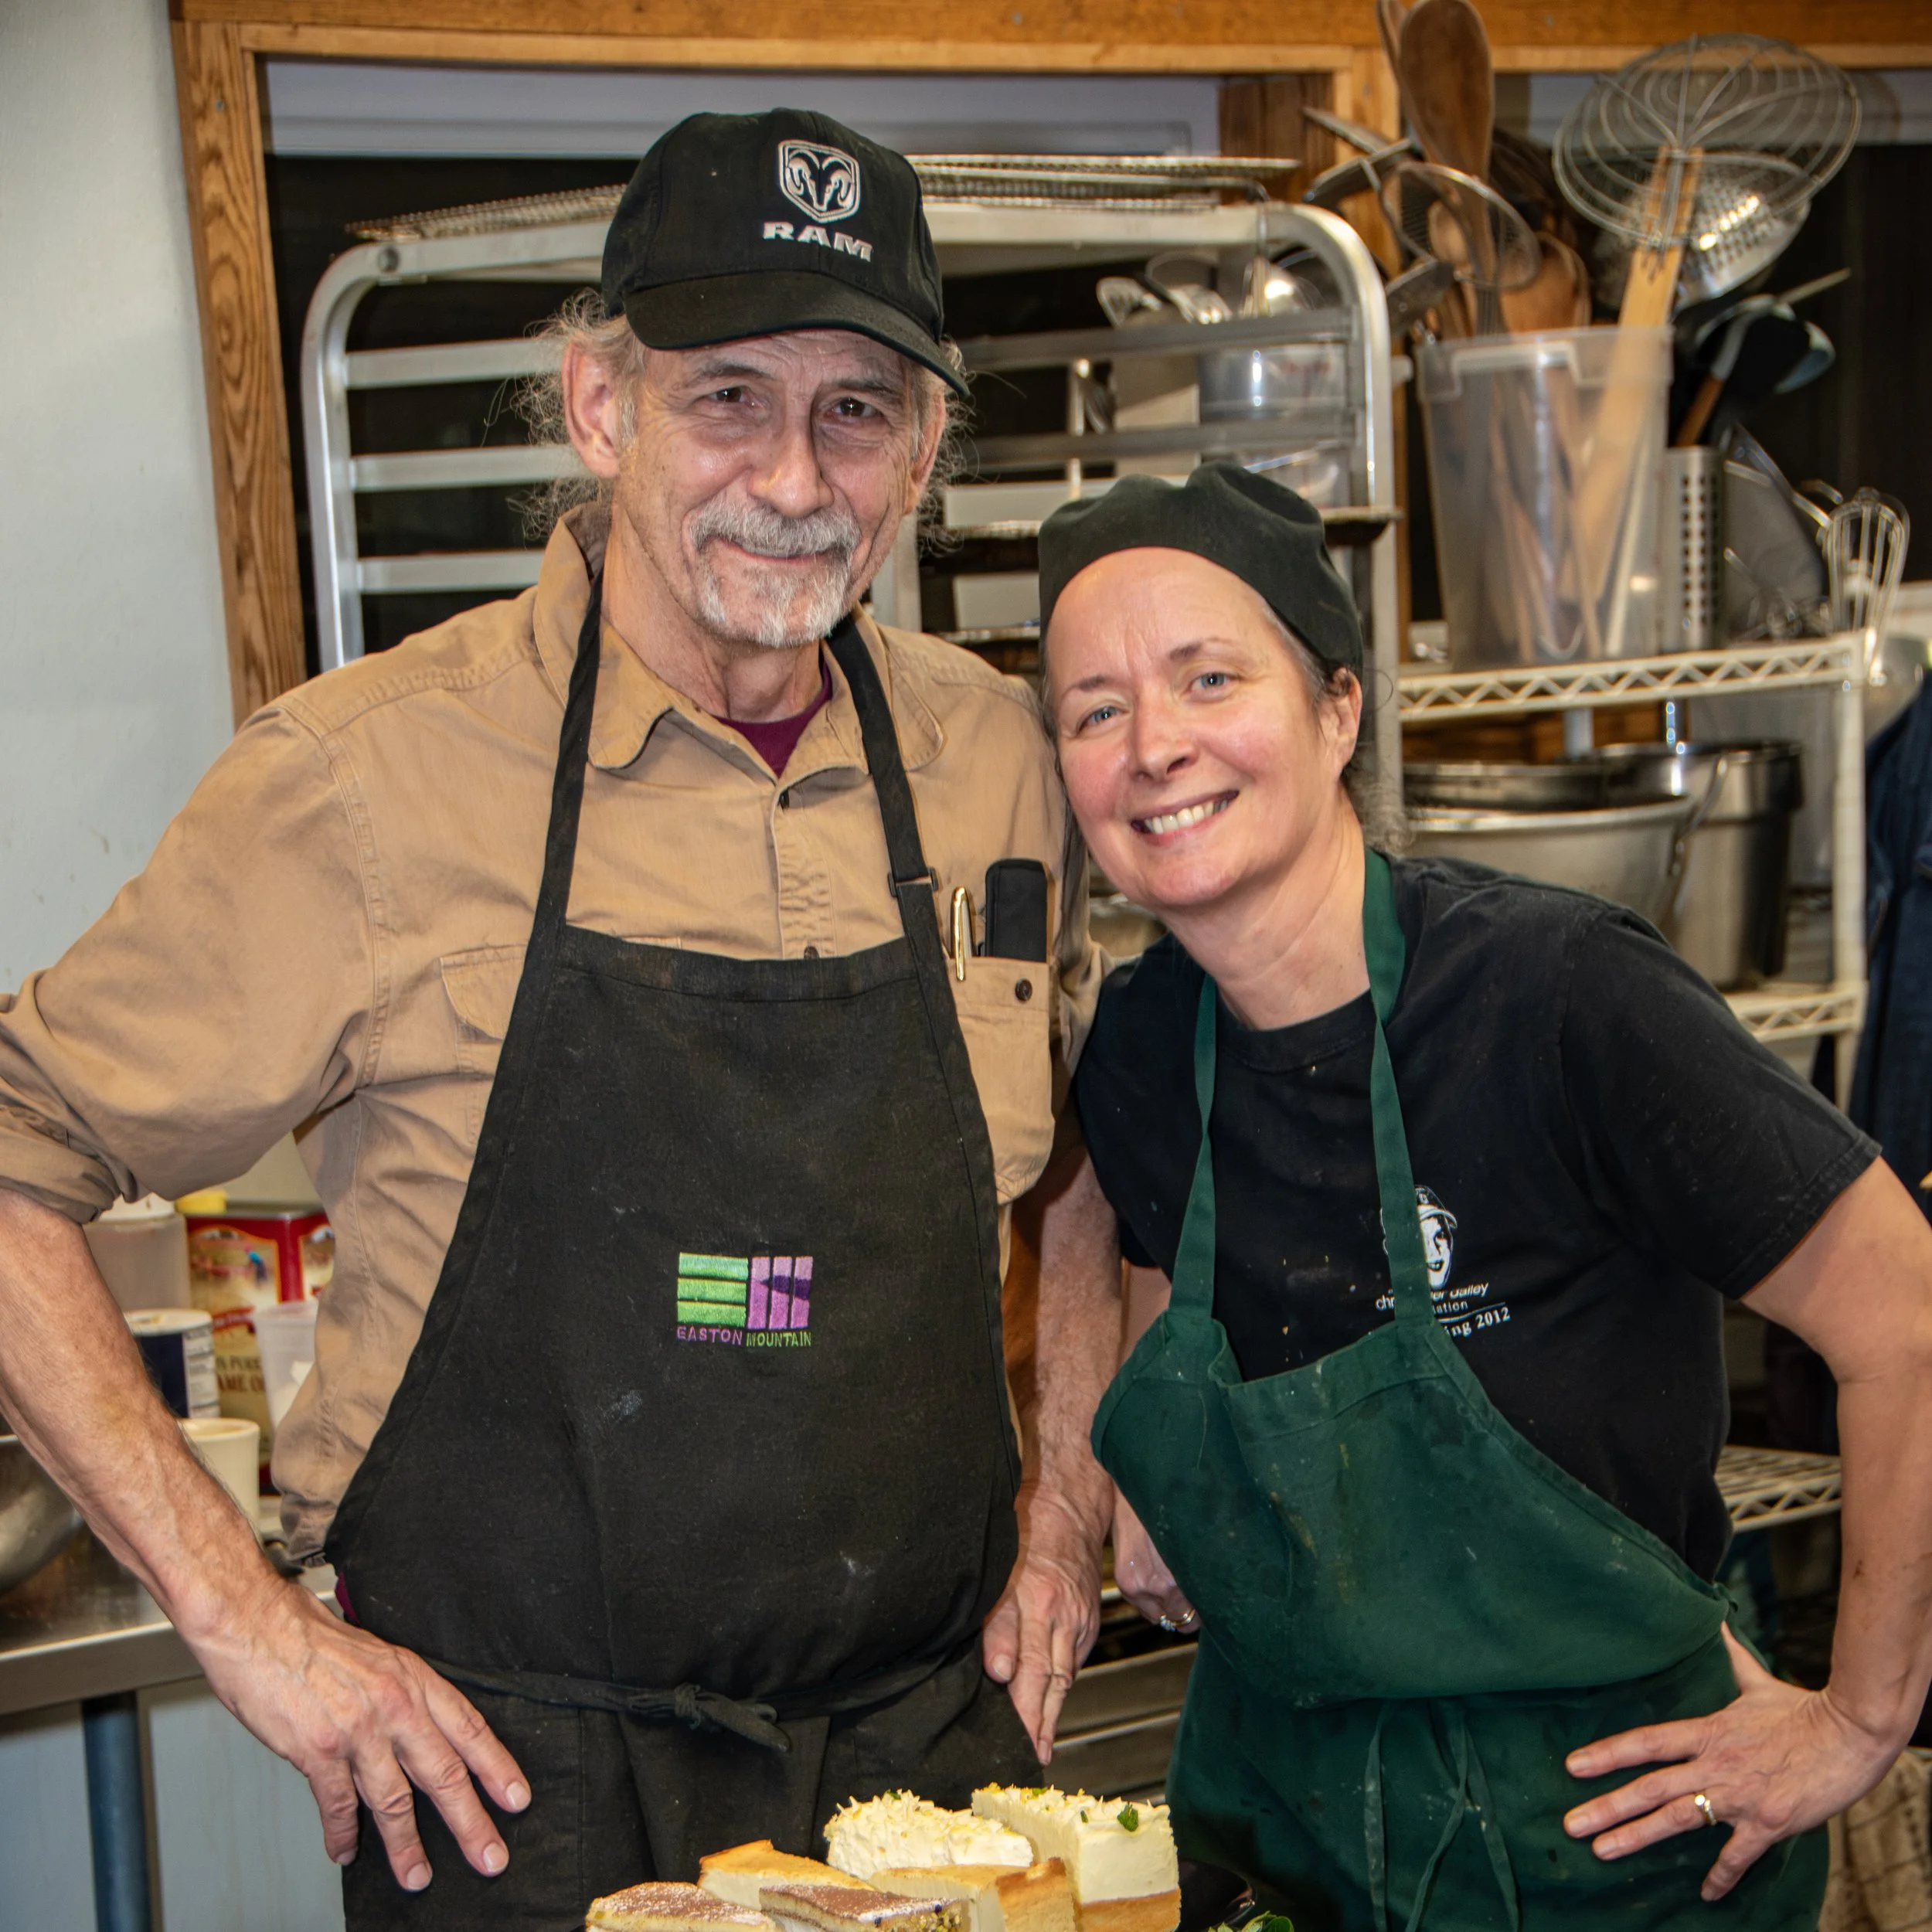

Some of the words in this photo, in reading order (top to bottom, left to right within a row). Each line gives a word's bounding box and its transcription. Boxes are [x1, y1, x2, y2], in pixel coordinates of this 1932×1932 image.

[764, 221, 872, 262] RAM
[1475, 1306, 1512, 1329] 2012
[676, 1325, 743, 1345] EASTON
[746, 1330, 811, 1348] MOUNTAIN
